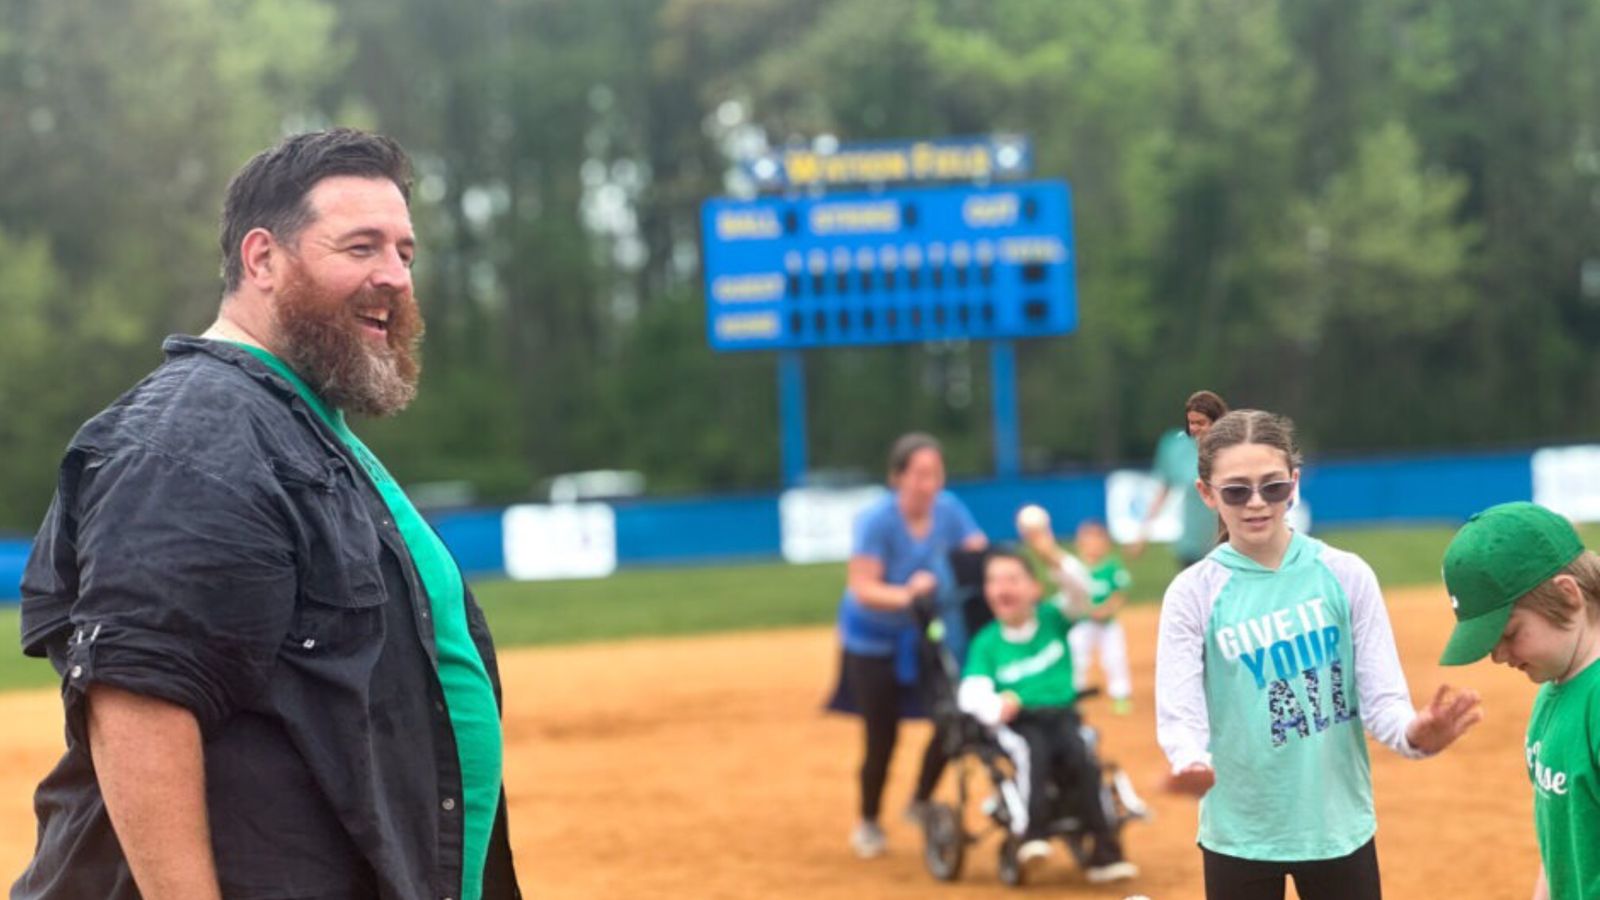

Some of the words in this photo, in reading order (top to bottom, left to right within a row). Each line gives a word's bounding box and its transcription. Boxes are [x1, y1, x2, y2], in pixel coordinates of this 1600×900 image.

[1217, 608, 1296, 662] GIVE
[1297, 598, 1327, 631] IT
[1240, 626, 1340, 690] YOUR
[1268, 659, 1357, 748] ALL
